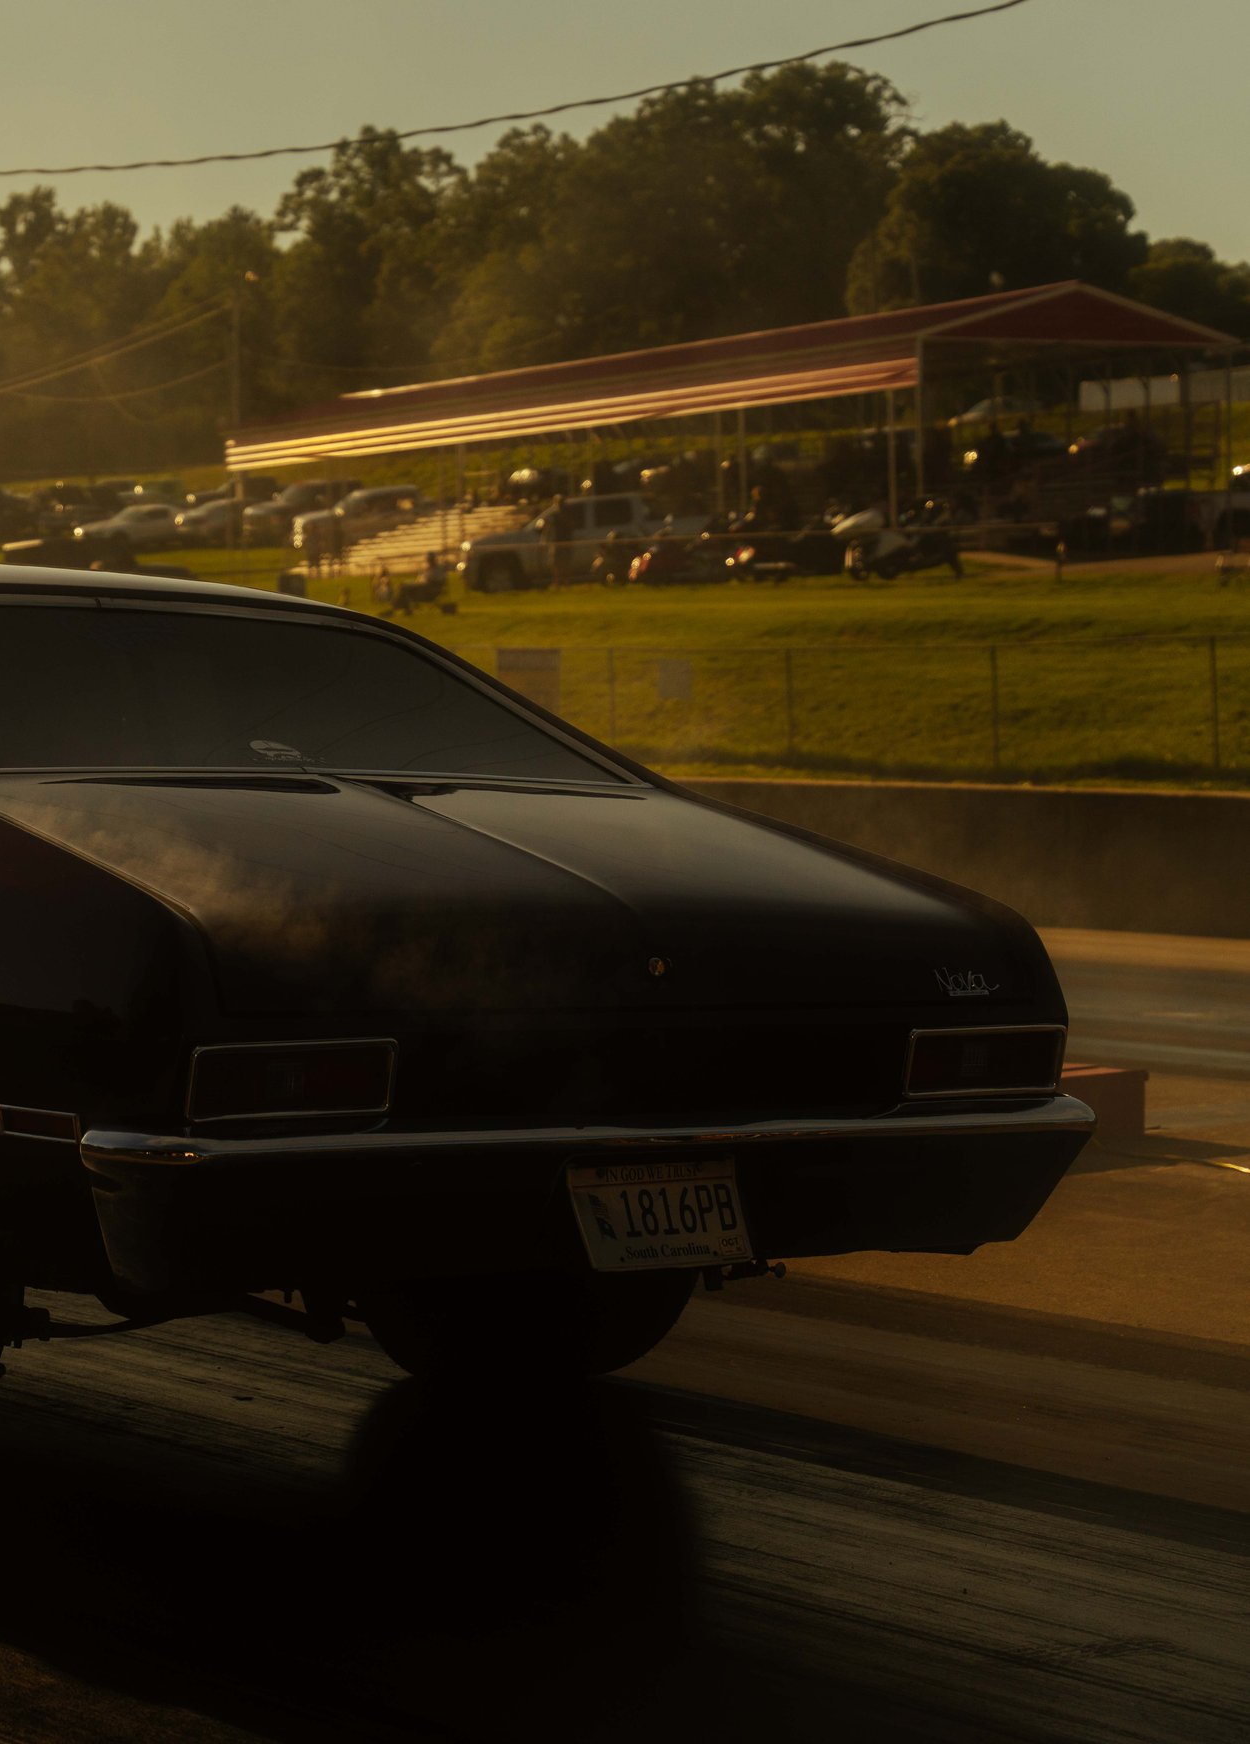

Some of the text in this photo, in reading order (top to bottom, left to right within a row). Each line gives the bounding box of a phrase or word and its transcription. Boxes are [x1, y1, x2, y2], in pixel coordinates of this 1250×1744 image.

[933, 967, 1000, 992] Nova
[605, 1163, 698, 1182] IN GOD WE TRUST
[619, 1183, 737, 1238] 1816PB
[625, 1245, 659, 1260] South
[661, 1243, 711, 1258] Carolina
[721, 1237, 740, 1247] OCT
